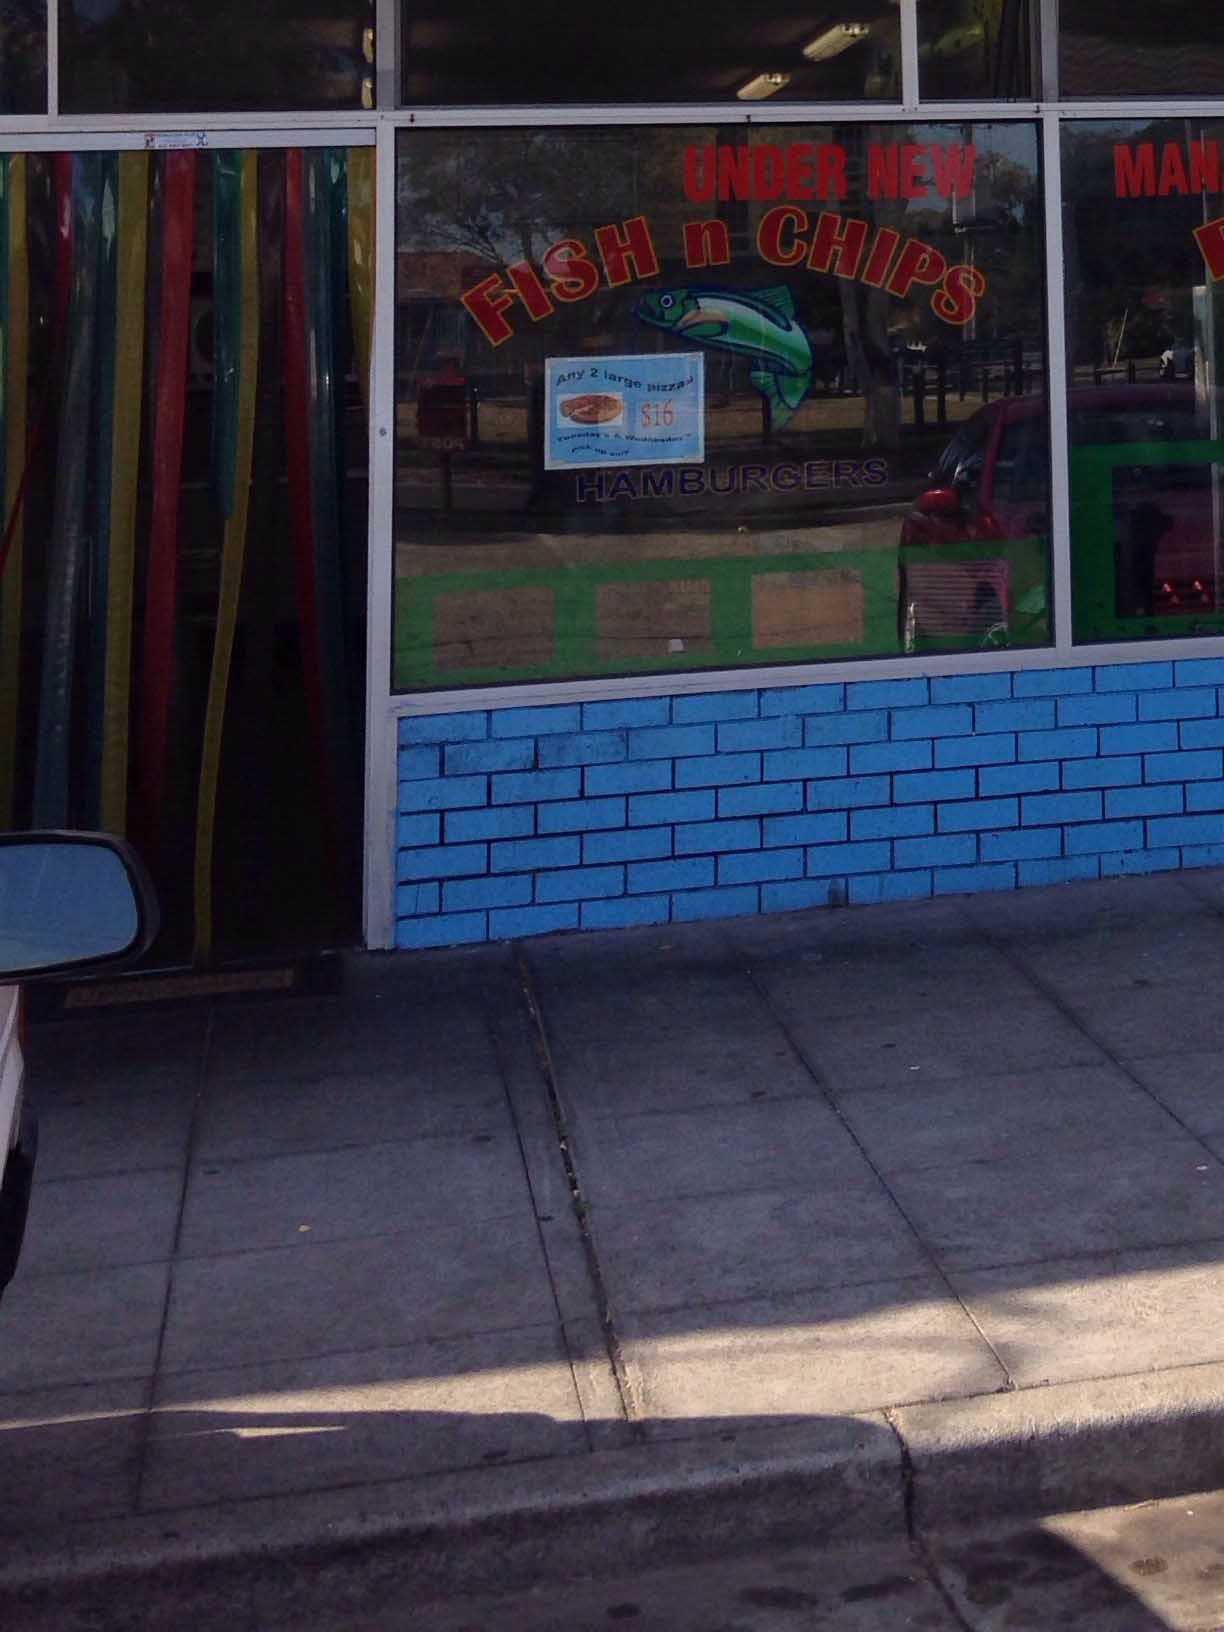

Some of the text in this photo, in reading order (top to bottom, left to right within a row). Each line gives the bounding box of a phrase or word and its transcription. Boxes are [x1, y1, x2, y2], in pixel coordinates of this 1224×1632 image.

[683, 143, 848, 202] UNDER
[867, 142, 977, 200] NEW
[460, 204, 986, 347] FISH n CHIPS
[556, 368, 586, 386] Any
[590, 367, 600, 378] 2
[604, 370, 642, 388] large
[575, 457, 889, 504] HAMBURGERS
